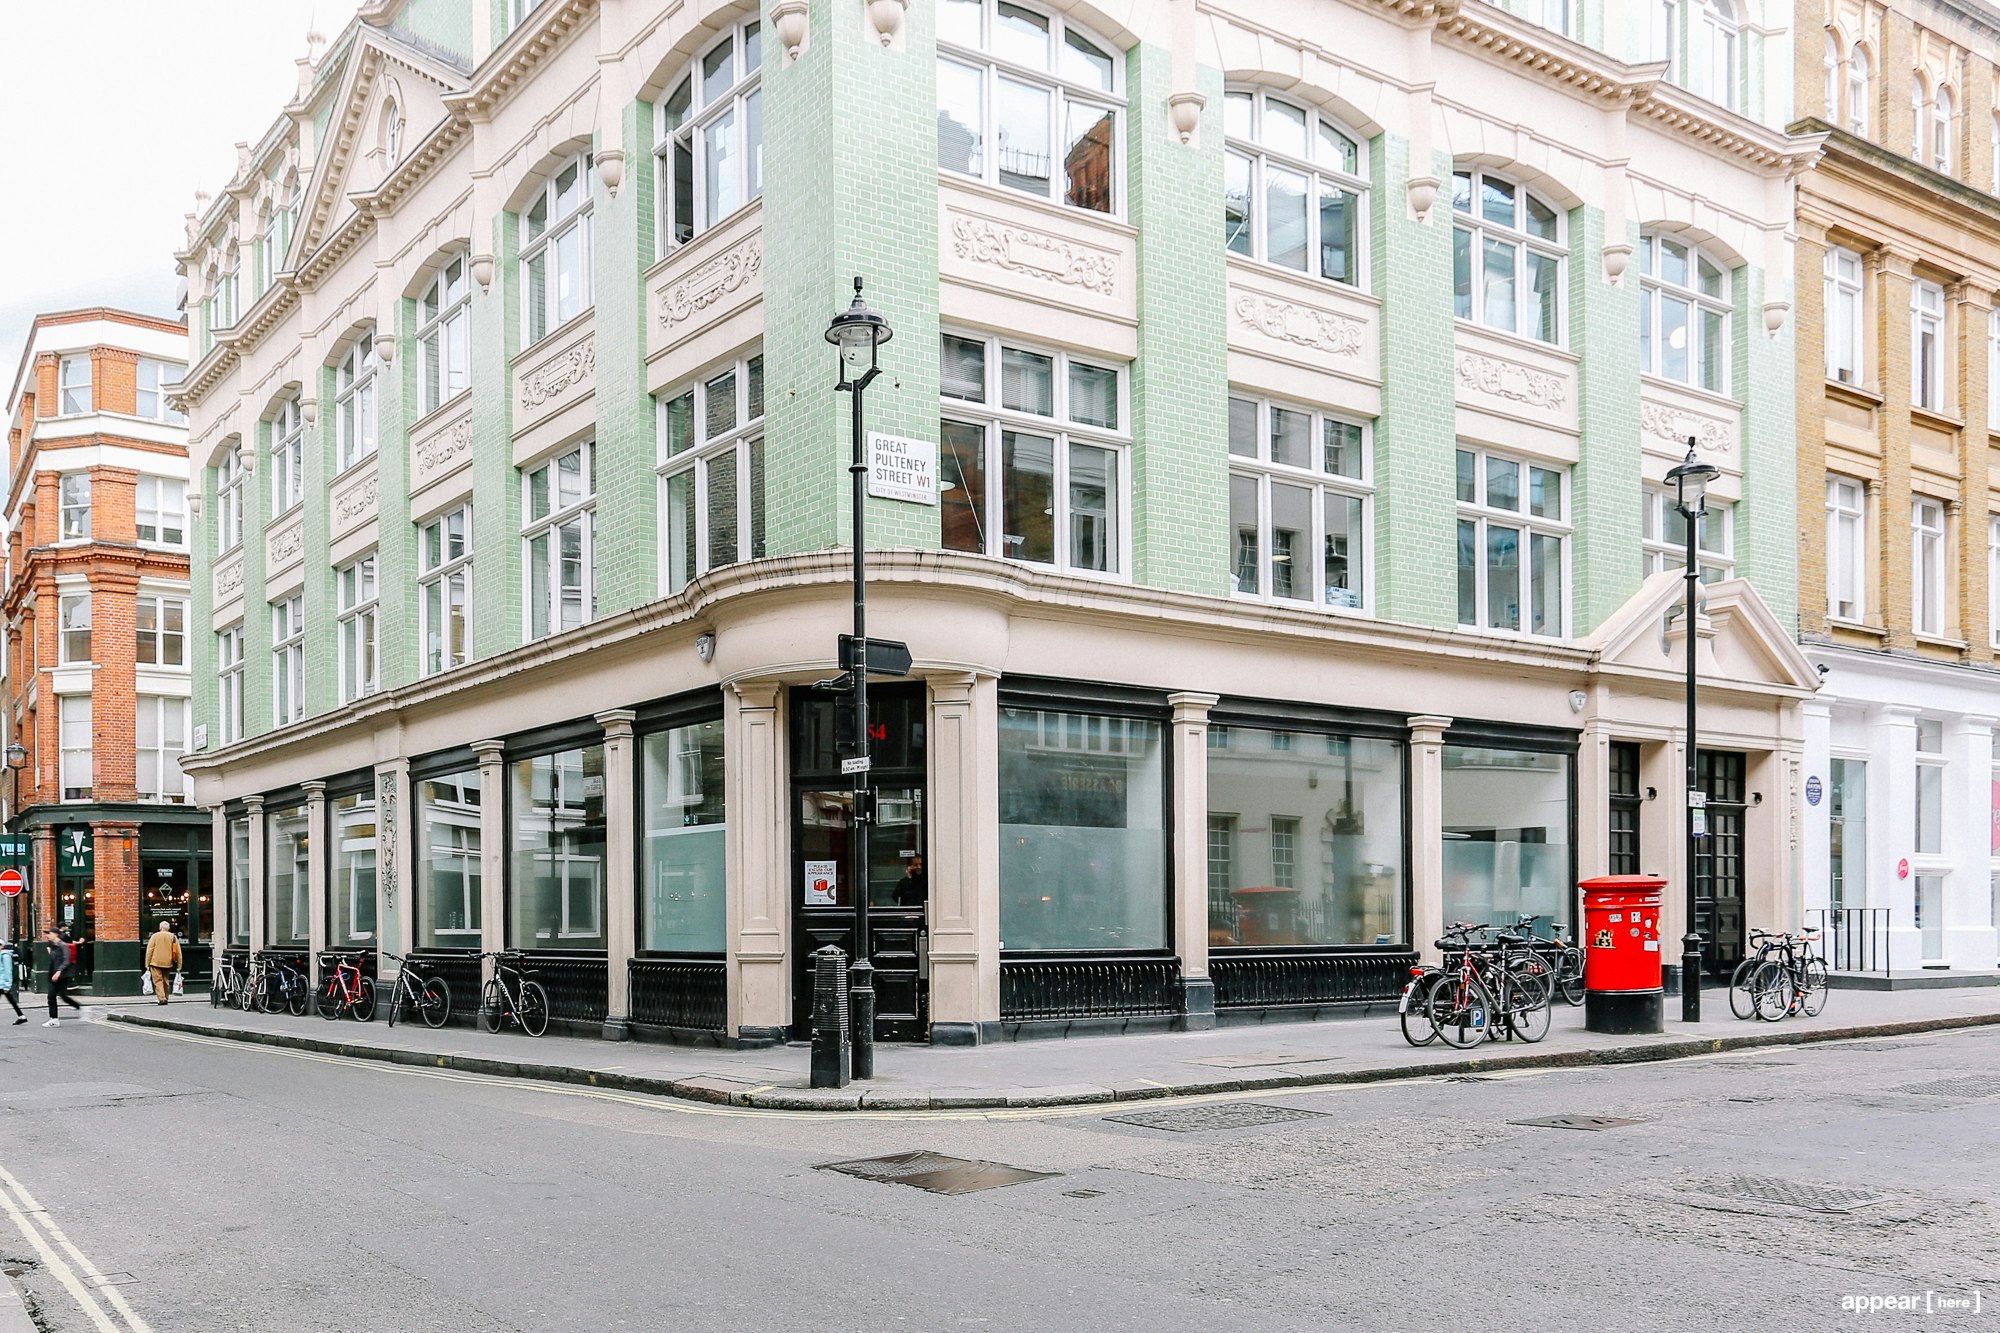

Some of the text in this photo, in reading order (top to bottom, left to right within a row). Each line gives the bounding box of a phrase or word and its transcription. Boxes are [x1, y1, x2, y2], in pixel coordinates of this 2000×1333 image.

[875, 438, 908, 455] GREAT
[875, 453, 927, 473] PULTENEY
[876, 467, 930, 488] STREET W1
[894, 490, 927, 500] WESTMINSTER
[1473, 1011, 1482, 1025] P
